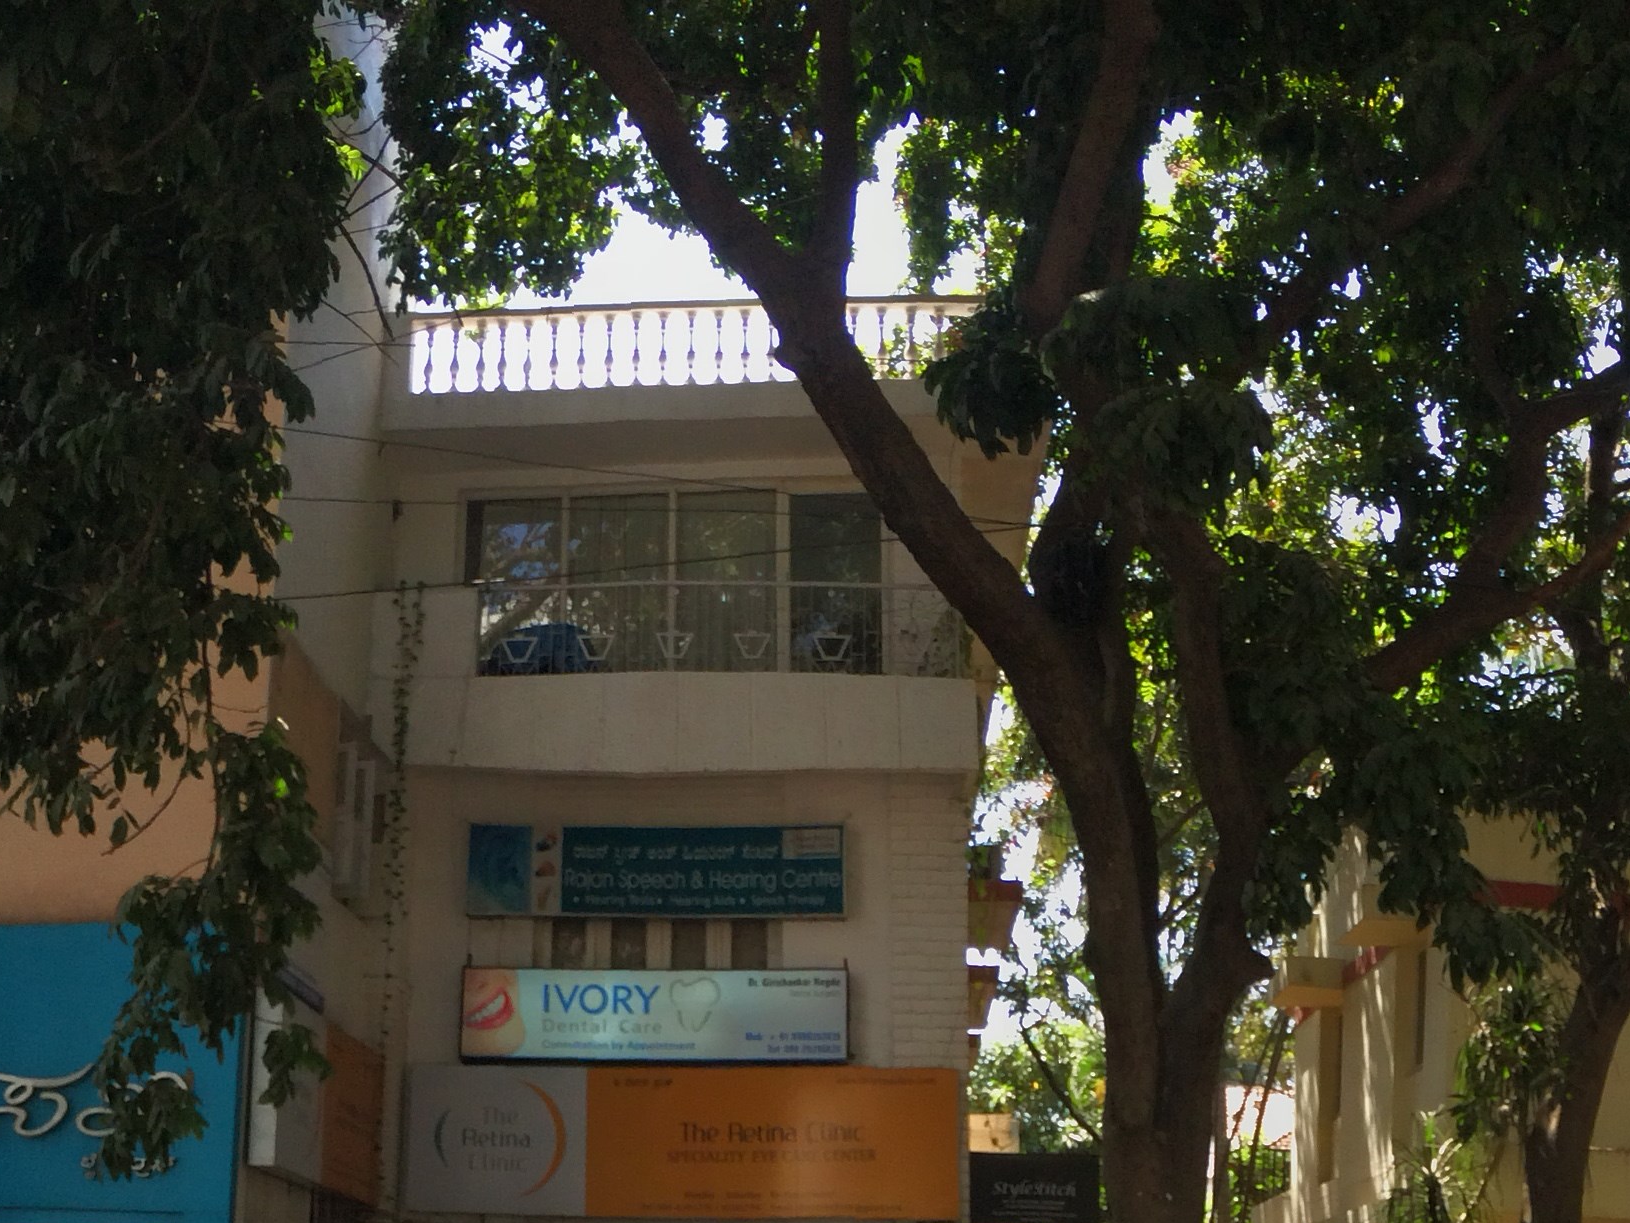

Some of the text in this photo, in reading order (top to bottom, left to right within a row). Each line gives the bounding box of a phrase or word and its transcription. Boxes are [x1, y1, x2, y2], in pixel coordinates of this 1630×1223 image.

[618, 869, 686, 892] Speech
[691, 870, 704, 889] &
[709, 869, 777, 893] Hearing
[782, 869, 842, 889] Centre
[542, 984, 661, 1015] IVORY
[542, 1019, 663, 1034] Dental Care
[483, 1106, 519, 1125] The
[462, 1127, 531, 1149] Retina
[680, 1121, 865, 1144] The Retina Clinic
[467, 1153, 530, 1172] Clinic
